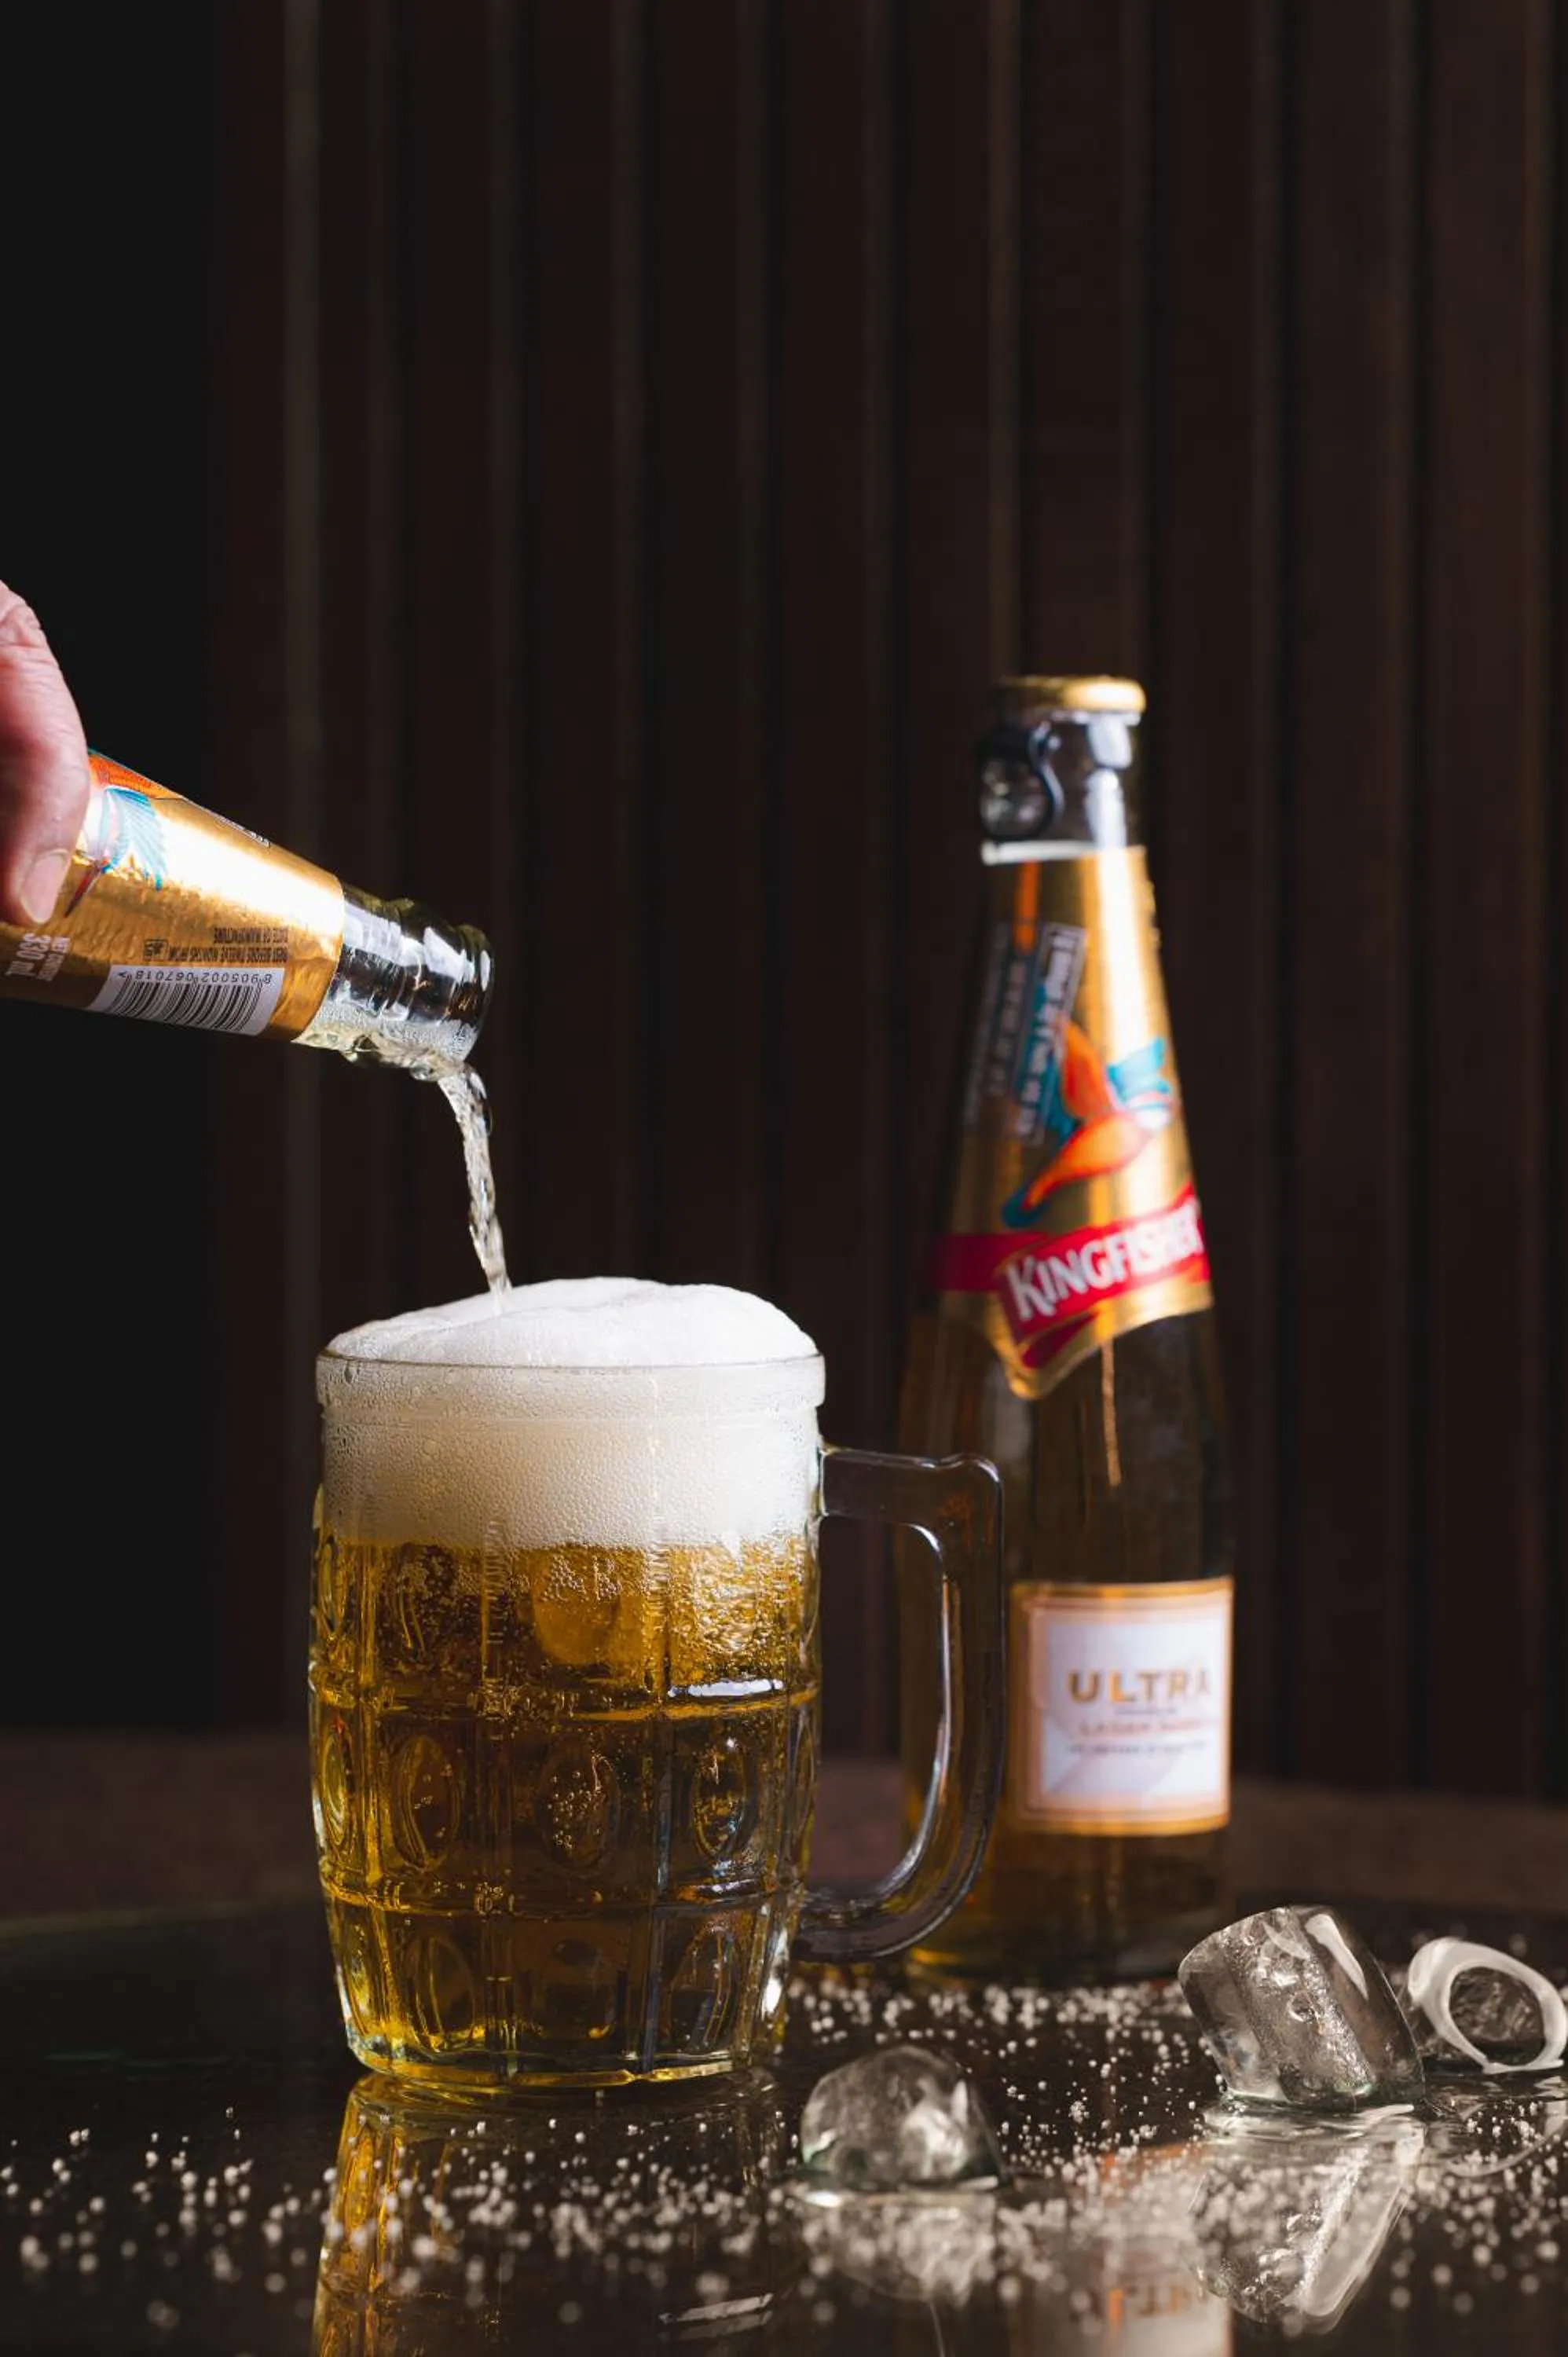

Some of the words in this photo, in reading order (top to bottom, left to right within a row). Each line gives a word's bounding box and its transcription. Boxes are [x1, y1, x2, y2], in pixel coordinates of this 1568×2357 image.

[16, 933, 52, 960] 330
[1006, 1197, 1204, 1321] KINGFISHER
[1068, 1667, 1212, 1705] ULTRA
